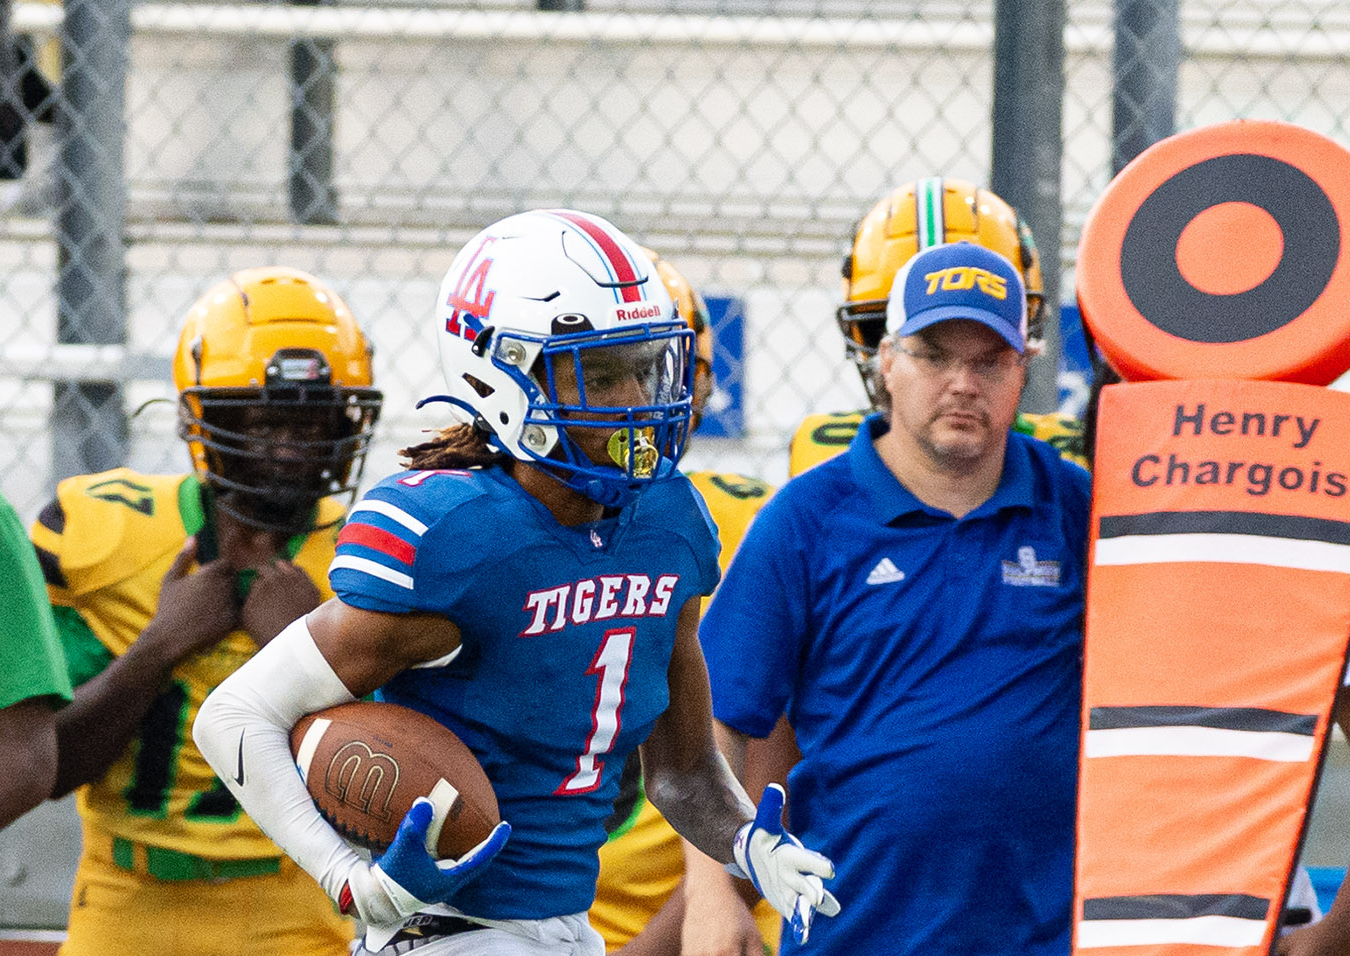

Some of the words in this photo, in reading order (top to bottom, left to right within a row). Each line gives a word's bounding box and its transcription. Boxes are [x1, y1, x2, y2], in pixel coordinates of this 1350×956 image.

[924, 266, 1008, 301] TORS
[616, 305, 662, 321] Riddell
[1172, 404, 1321, 448] Henry
[1131, 454, 1348, 497] Chargois
[518, 573, 681, 638] TIGERS
[552, 626, 637, 797] 1
